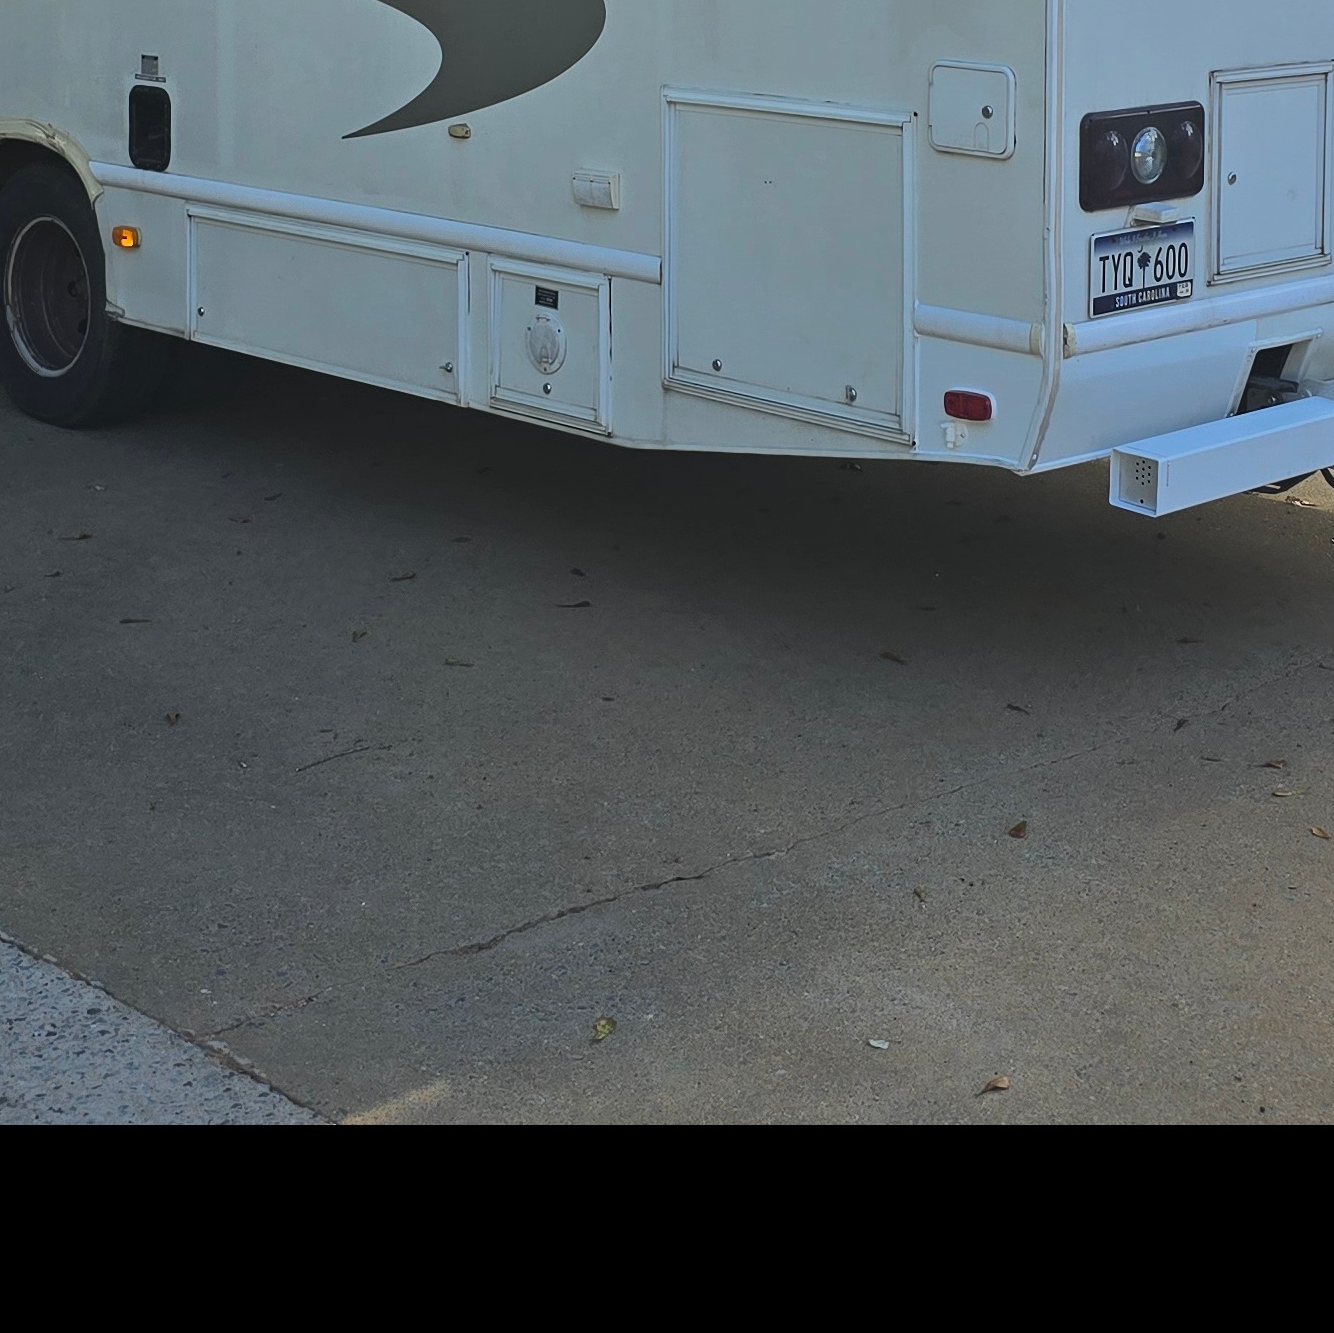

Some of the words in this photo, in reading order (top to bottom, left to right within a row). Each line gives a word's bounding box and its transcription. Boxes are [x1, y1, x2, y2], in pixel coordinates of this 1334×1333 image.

[1099, 252, 1133, 292] TYQ
[1154, 243, 1188, 282] 600
[1115, 294, 1136, 307] SOUTH
[1138, 287, 1170, 302] CAROLINA
